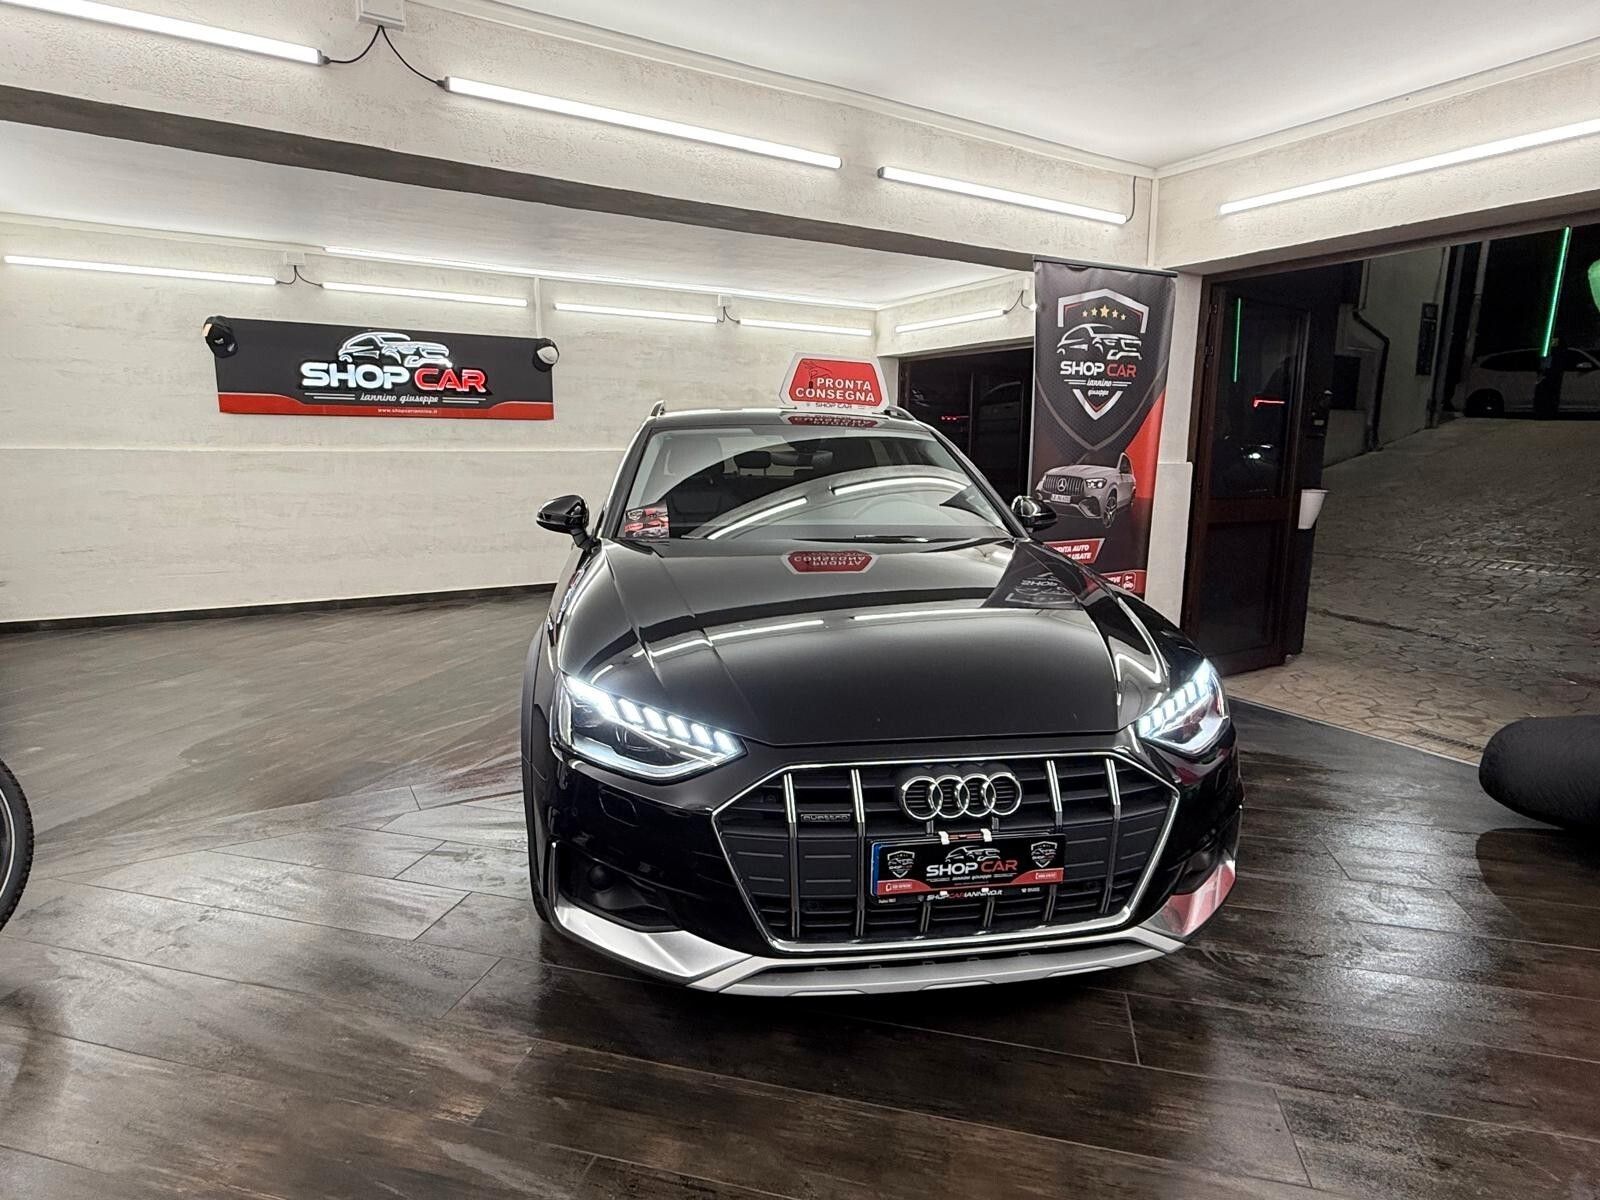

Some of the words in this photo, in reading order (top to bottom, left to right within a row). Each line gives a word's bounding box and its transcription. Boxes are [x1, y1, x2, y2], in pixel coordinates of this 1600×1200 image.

[1060, 360, 1105, 376] SHOP
[1106, 363, 1136, 377] CAR
[300, 361, 411, 390] SHOP
[413, 367, 487, 393] CAR
[816, 377, 872, 390] PRONTA
[360, 392, 397, 402] iannino
[400, 394, 439, 405] giuseppe
[795, 387, 875, 402] CONSEGNA
[1072, 544, 1090, 552] AUTO
[926, 862, 979, 877] SHOP
[980, 860, 1019, 873] CAR
